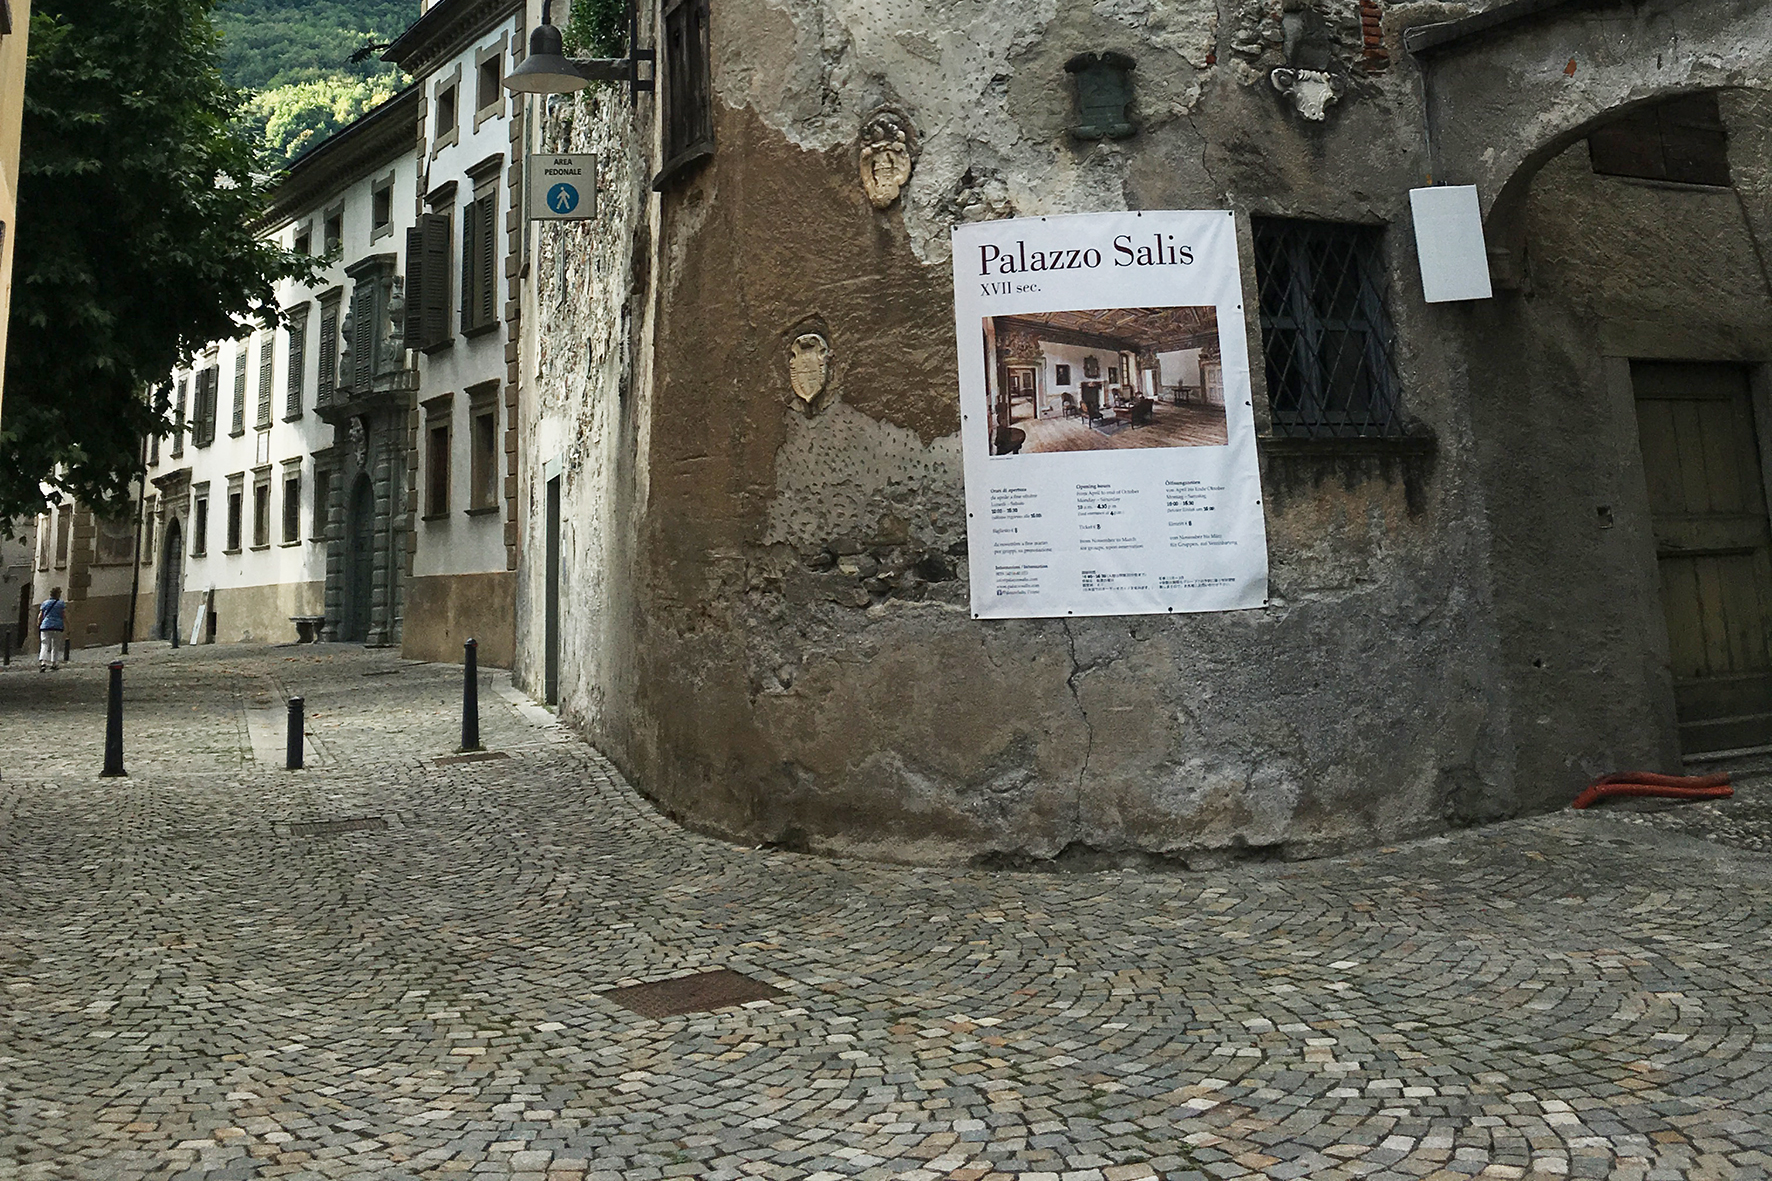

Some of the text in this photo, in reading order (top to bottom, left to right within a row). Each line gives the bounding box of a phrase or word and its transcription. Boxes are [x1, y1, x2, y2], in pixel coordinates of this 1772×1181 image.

[978, 232, 1194, 276] Palazzo Salis
[980, 281, 1042, 296] XVII sec.
